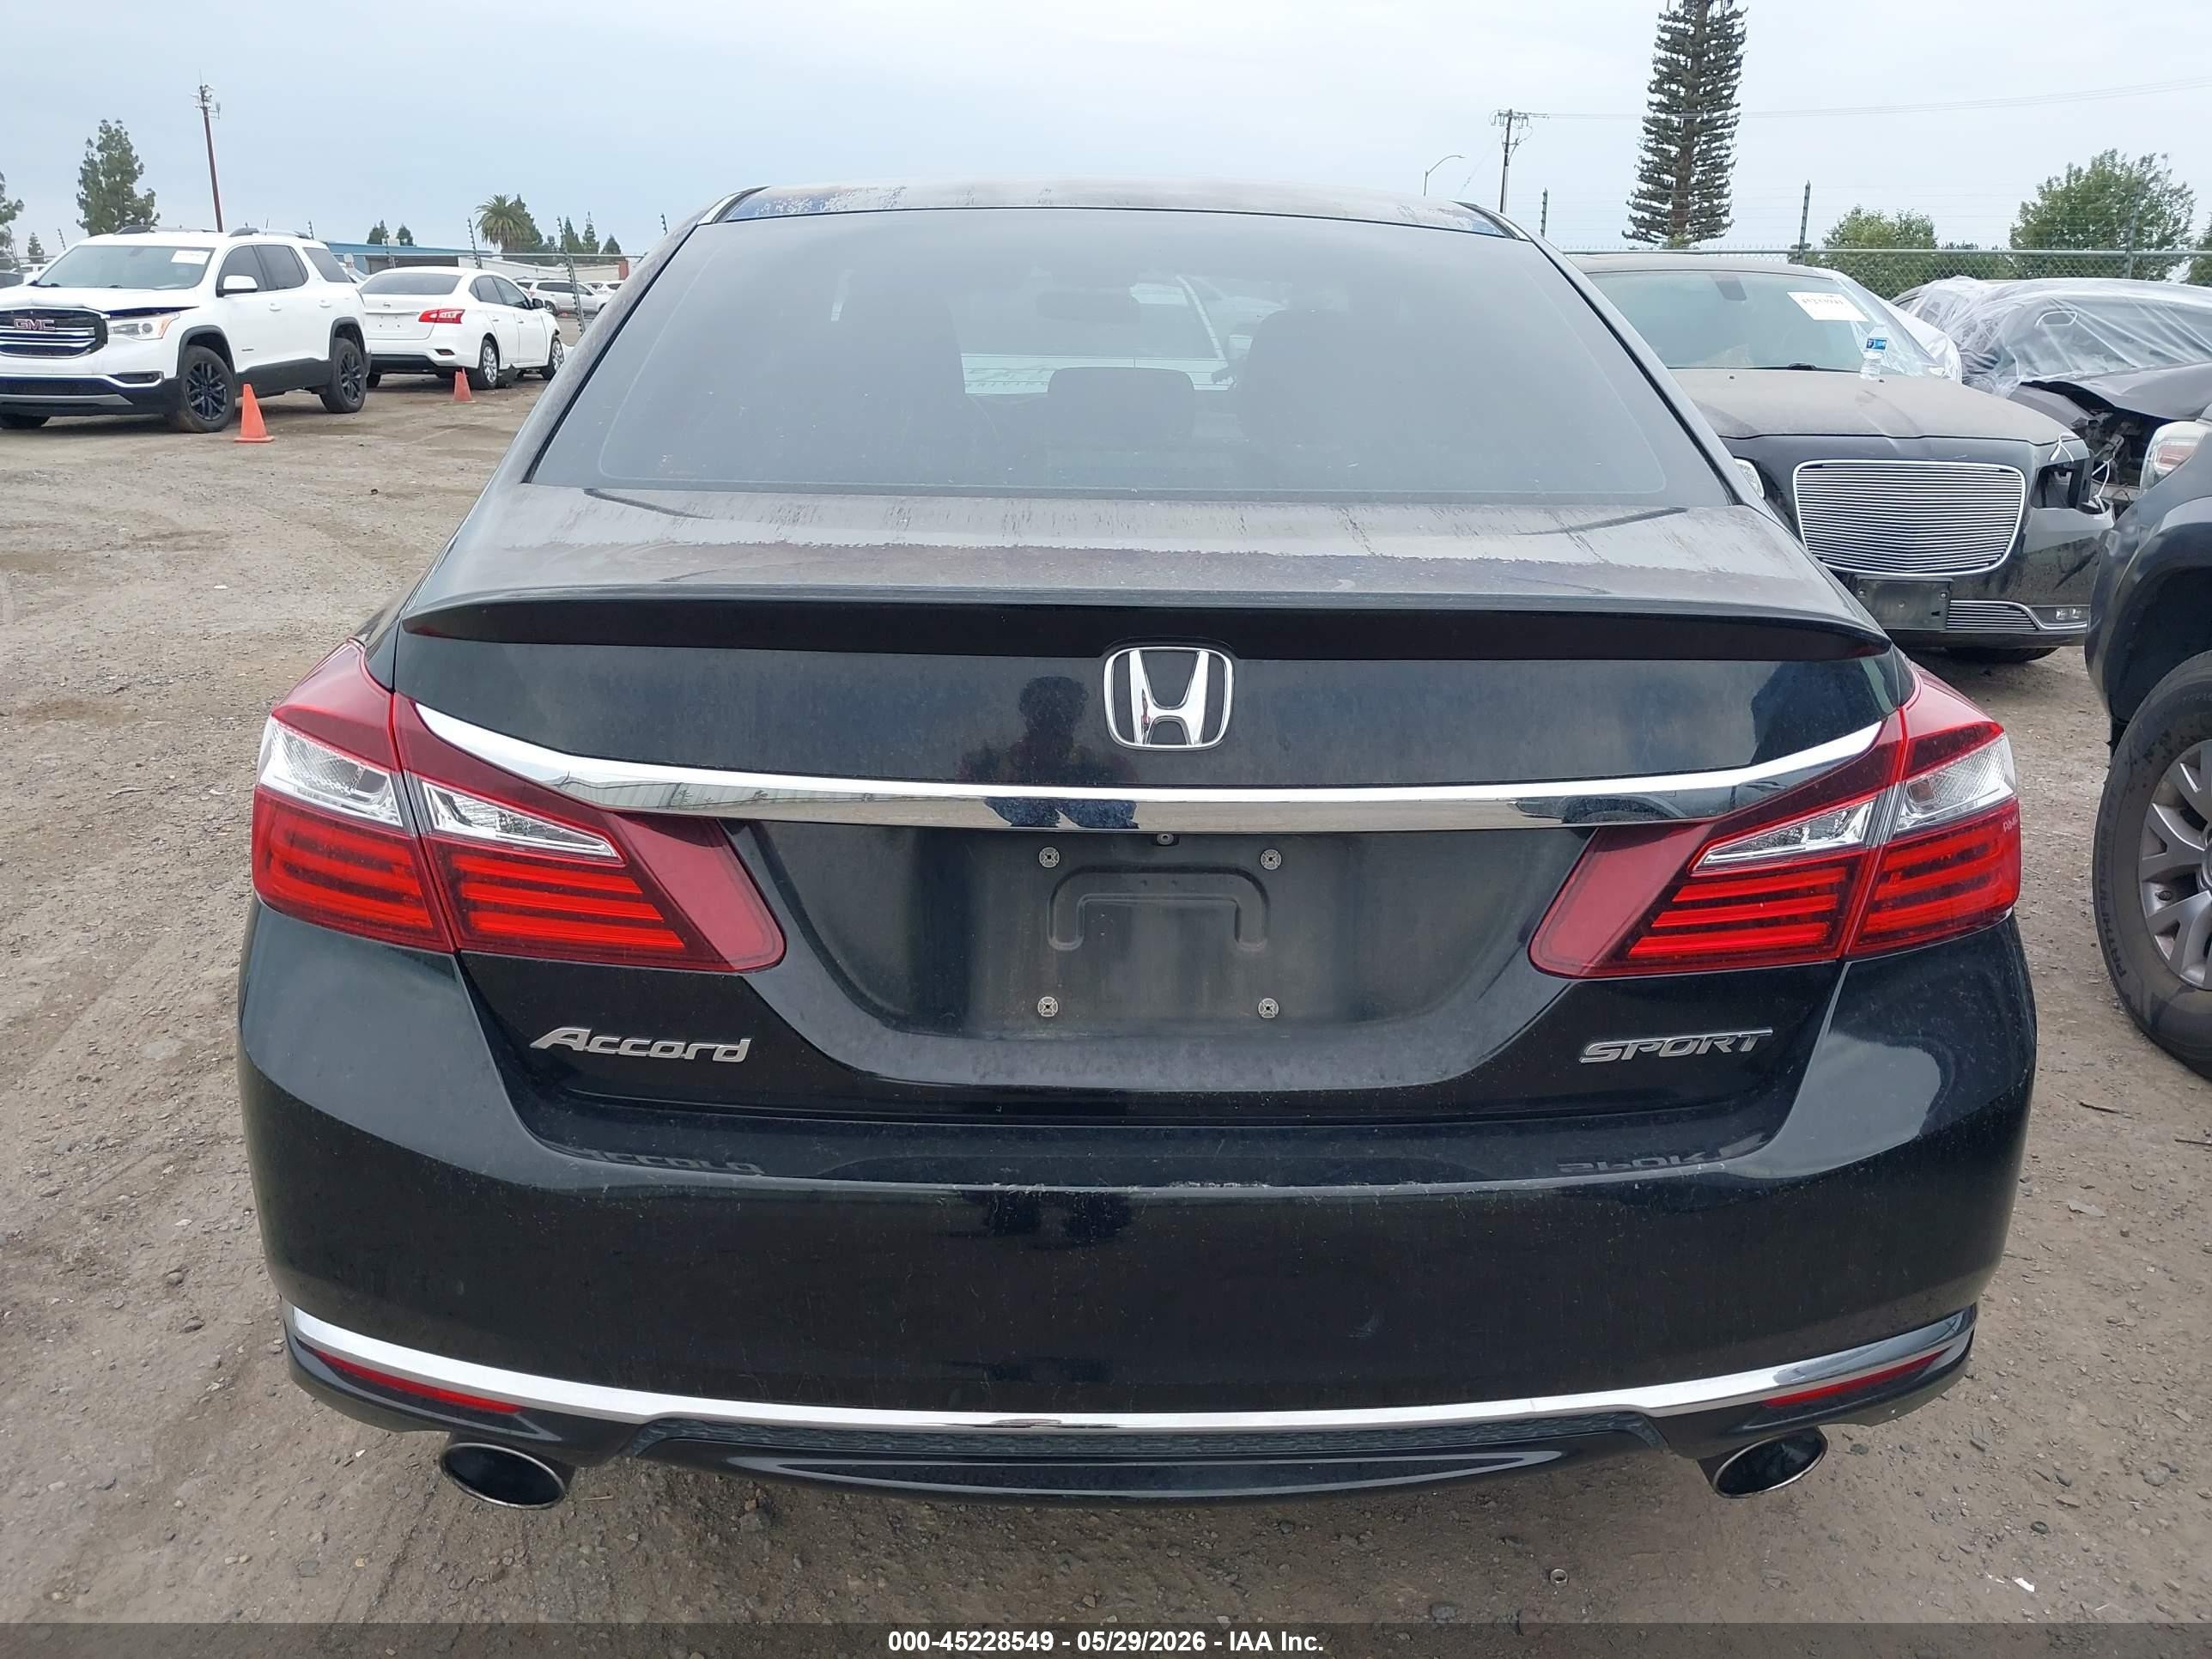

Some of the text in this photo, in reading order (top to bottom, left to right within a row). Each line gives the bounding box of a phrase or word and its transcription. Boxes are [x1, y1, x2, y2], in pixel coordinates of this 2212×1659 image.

[14, 319, 56, 331] GMC
[530, 1026, 751, 1063] Accord
[1579, 1028, 1773, 1063] SPORT
